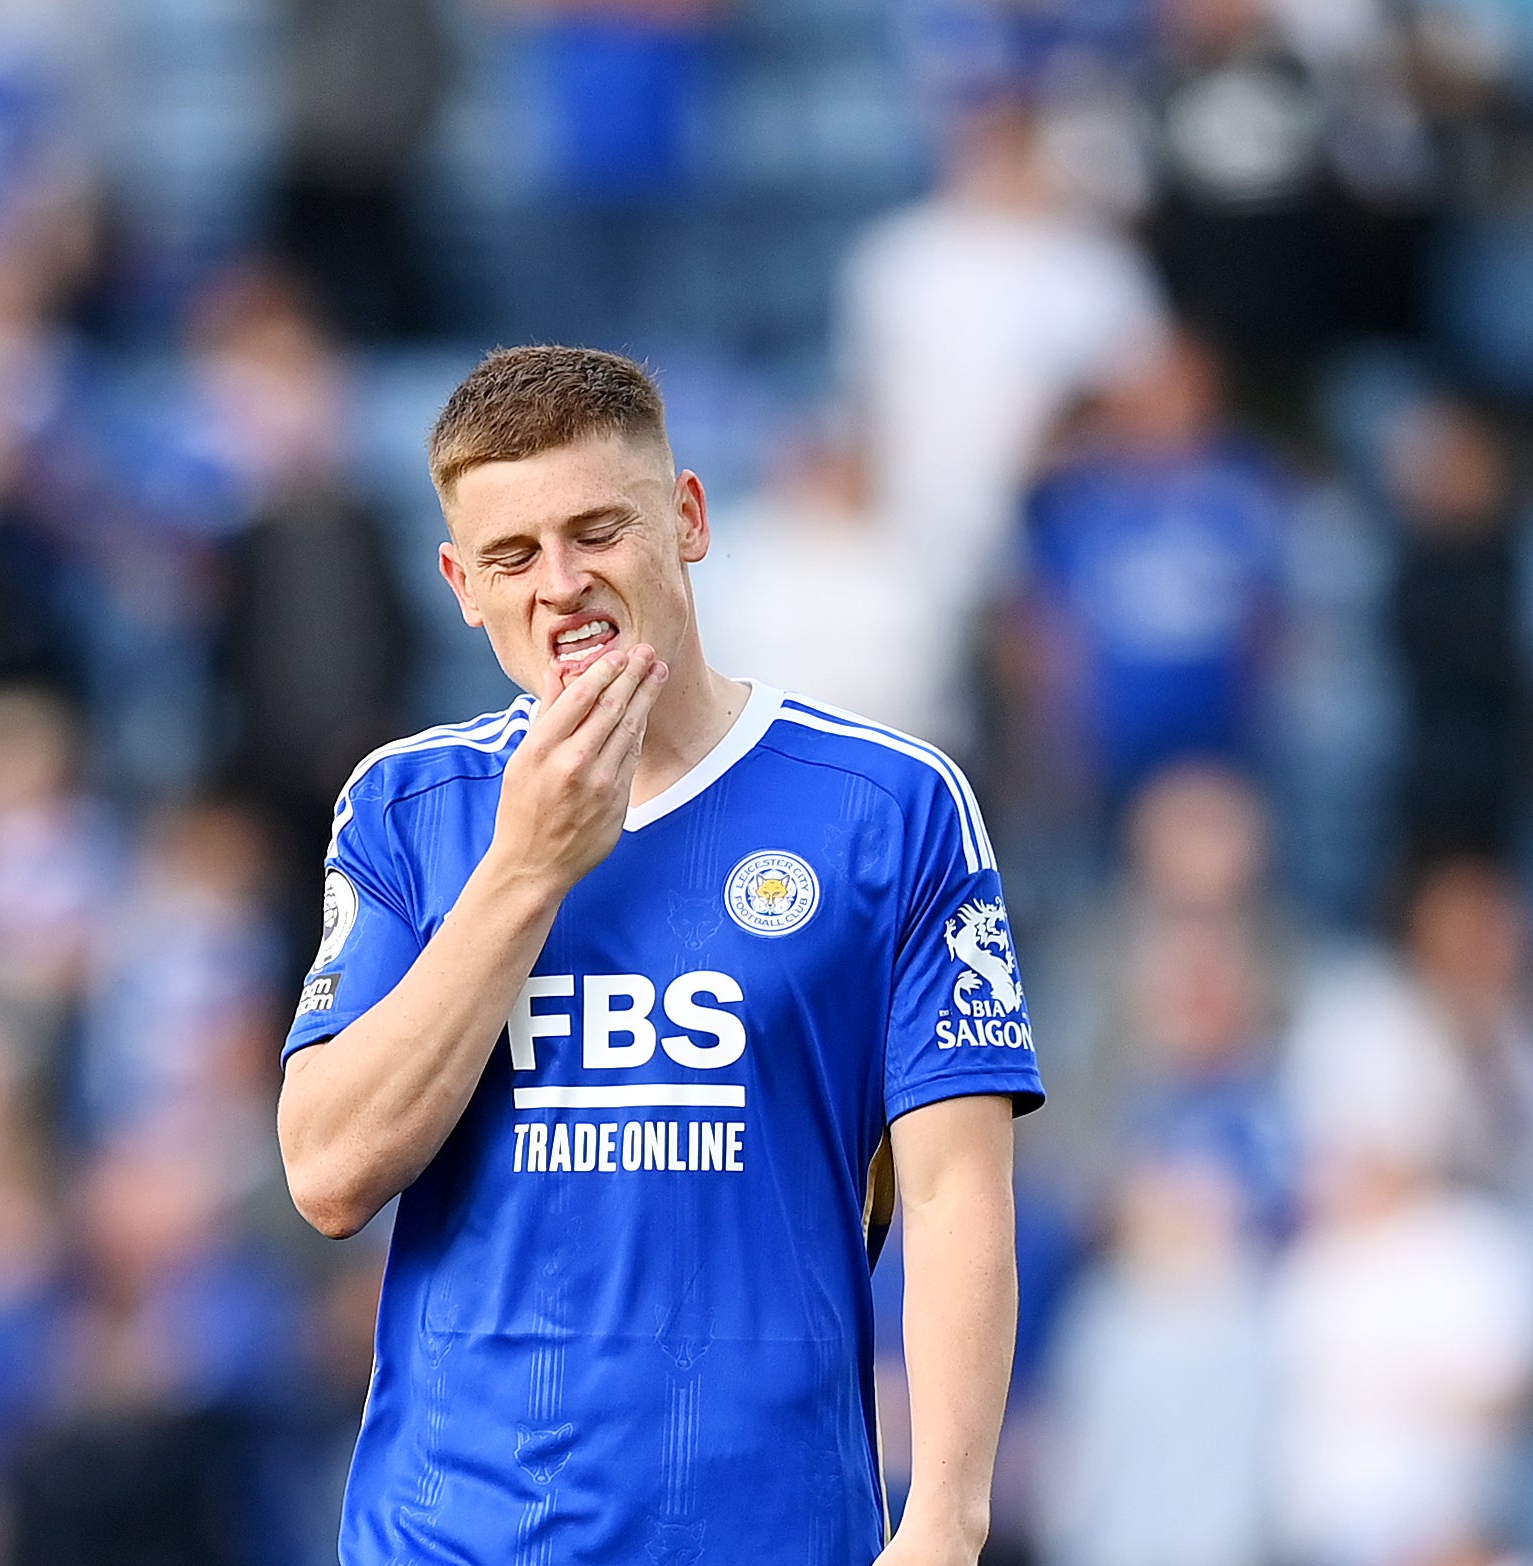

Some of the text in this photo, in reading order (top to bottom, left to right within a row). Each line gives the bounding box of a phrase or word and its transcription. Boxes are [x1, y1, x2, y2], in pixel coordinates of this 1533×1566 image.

[736, 859, 809, 892] LEICESTER CITY
[734, 895, 808, 927] FOOTBALL CLUB
[507, 970, 747, 1070] FBS
[971, 1000, 1006, 1018] BIA
[935, 1019, 1036, 1052] SAIGON
[513, 1121, 745, 1172] TRADE ONLINE
